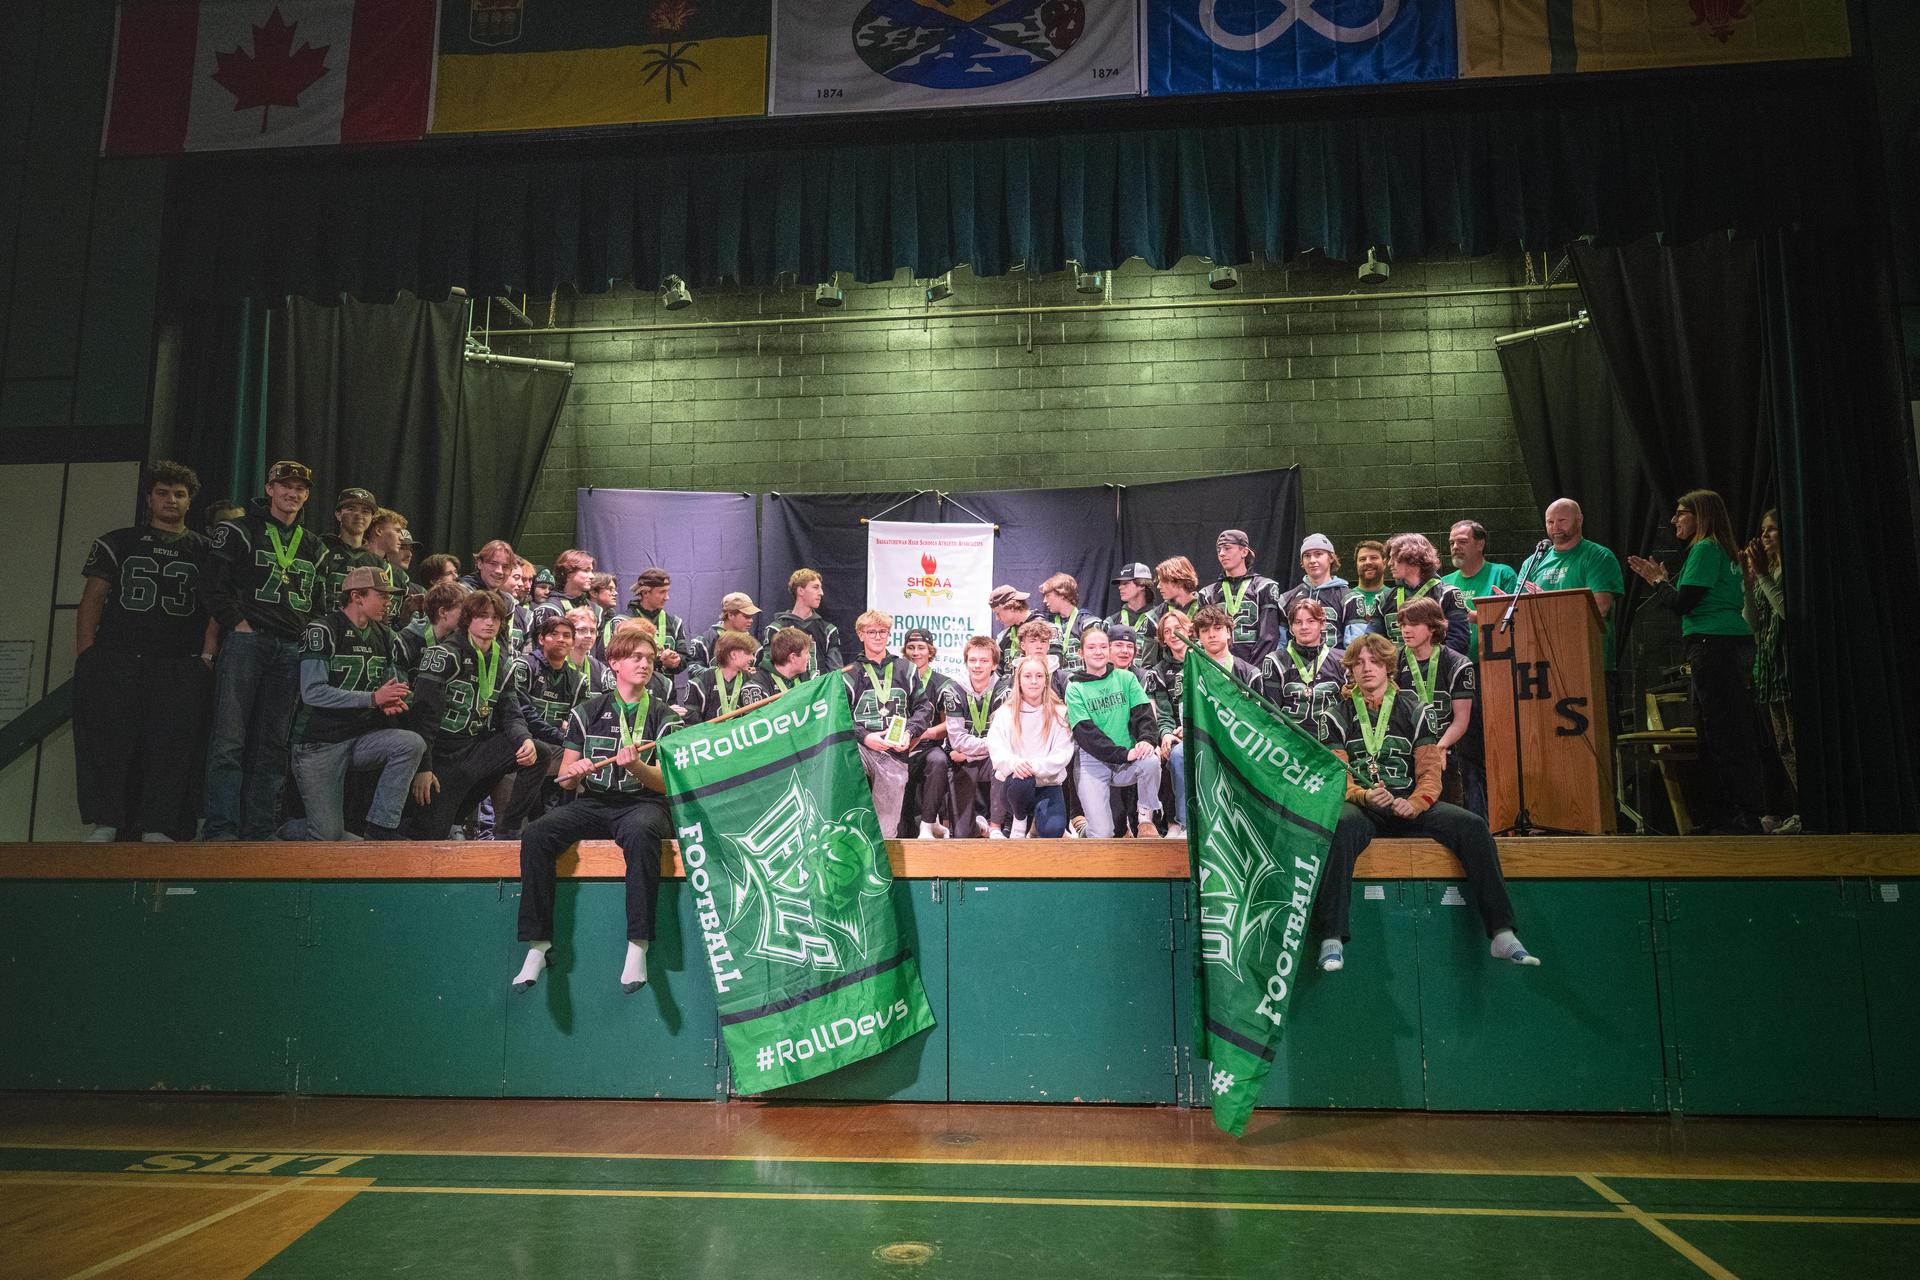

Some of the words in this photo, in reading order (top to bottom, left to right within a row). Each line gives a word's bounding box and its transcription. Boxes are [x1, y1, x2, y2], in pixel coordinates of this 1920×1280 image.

[816, 88, 844, 99] 1874
[1091, 68, 1120, 79] 1874
[153, 547, 179, 557] DEVILS
[120, 555, 199, 616] 63
[255, 550, 316, 613] 73
[907, 577, 952, 588] SHSAA
[890, 615, 975, 631] ROVINCIAL
[420, 649, 449, 672] 85
[854, 687, 908, 730] 43
[673, 698, 829, 771] #RollDevs
[679, 821, 743, 994] FOOTBALL
[1255, 855, 1321, 1026] FOOTBALL
[756, 998, 909, 1072] #RollDevs
